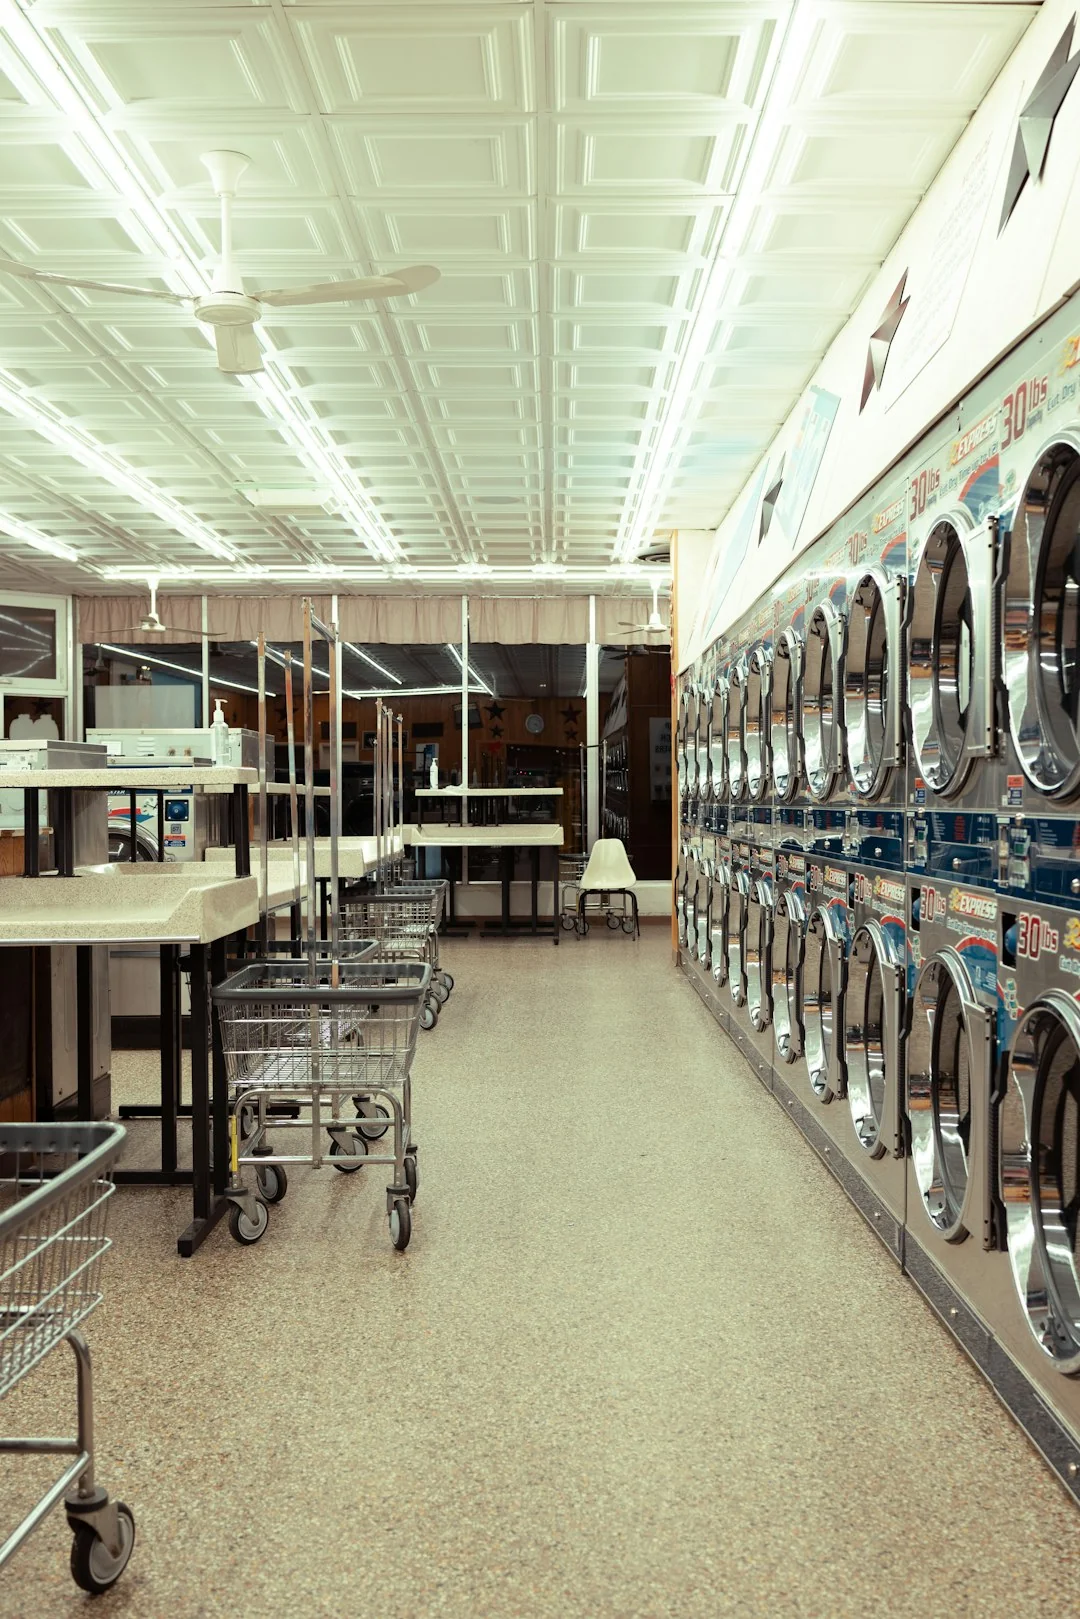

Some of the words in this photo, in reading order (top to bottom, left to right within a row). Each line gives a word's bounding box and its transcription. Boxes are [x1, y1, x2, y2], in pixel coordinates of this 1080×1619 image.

[1001, 381, 1027, 451] 30
[1028, 376, 1048, 412] lbs
[957, 413, 997, 460] EXPRESS
[910, 469, 927, 521] 30
[927, 467, 940, 494] lbs
[855, 873, 865, 903] 30
[880, 881, 905, 902] EXPRESS
[920, 885, 936, 922] 30
[935, 891, 946, 915] lbs
[959, 896, 997, 919] EXPRESS
[1018, 912, 1041, 961] 30
[1041, 921, 1058, 953] lbs
